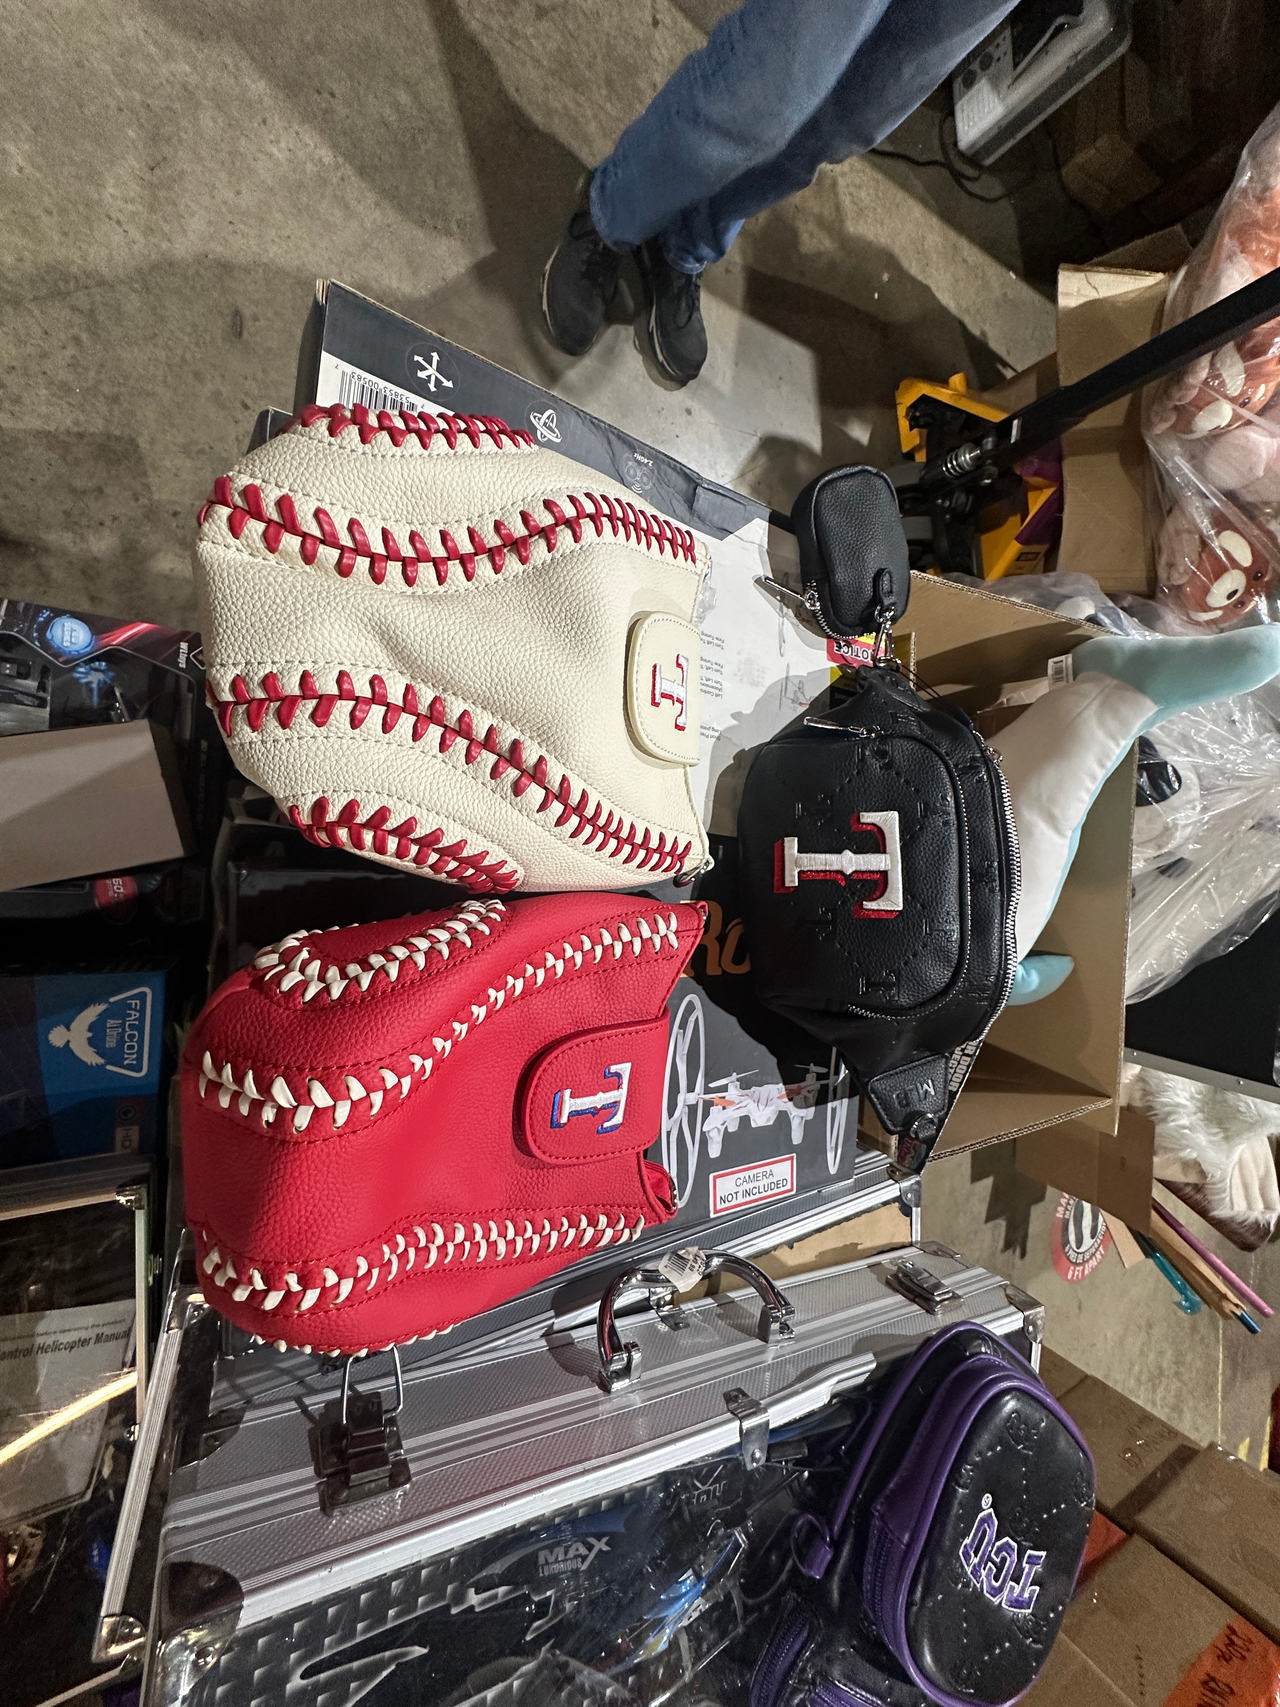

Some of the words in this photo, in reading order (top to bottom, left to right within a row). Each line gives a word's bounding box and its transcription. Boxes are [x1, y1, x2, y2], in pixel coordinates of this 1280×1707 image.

[351, 371, 379, 390] 00583
[383, 386, 410, 403] 53853
[833, 639, 873, 663] OTICE
[651, 653, 690, 731] T
[773, 811, 903, 919] T
[123, 999, 141, 1066] FALCON
[550, 1062, 632, 1135] T
[719, 1189, 740, 1205] NOT
[742, 1178, 788, 1200] INCLUDED
[735, 1169, 774, 1187] CAMERA
[1073, 1265, 1084, 1280] FT
[1084, 1244, 1105, 1277] APART
[36, 1336, 92, 1355] Helicopter
[94, 1329, 130, 1345] Manual
[537, 1536, 612, 1570] MAX
[959, 1508, 1047, 1613] TCU
